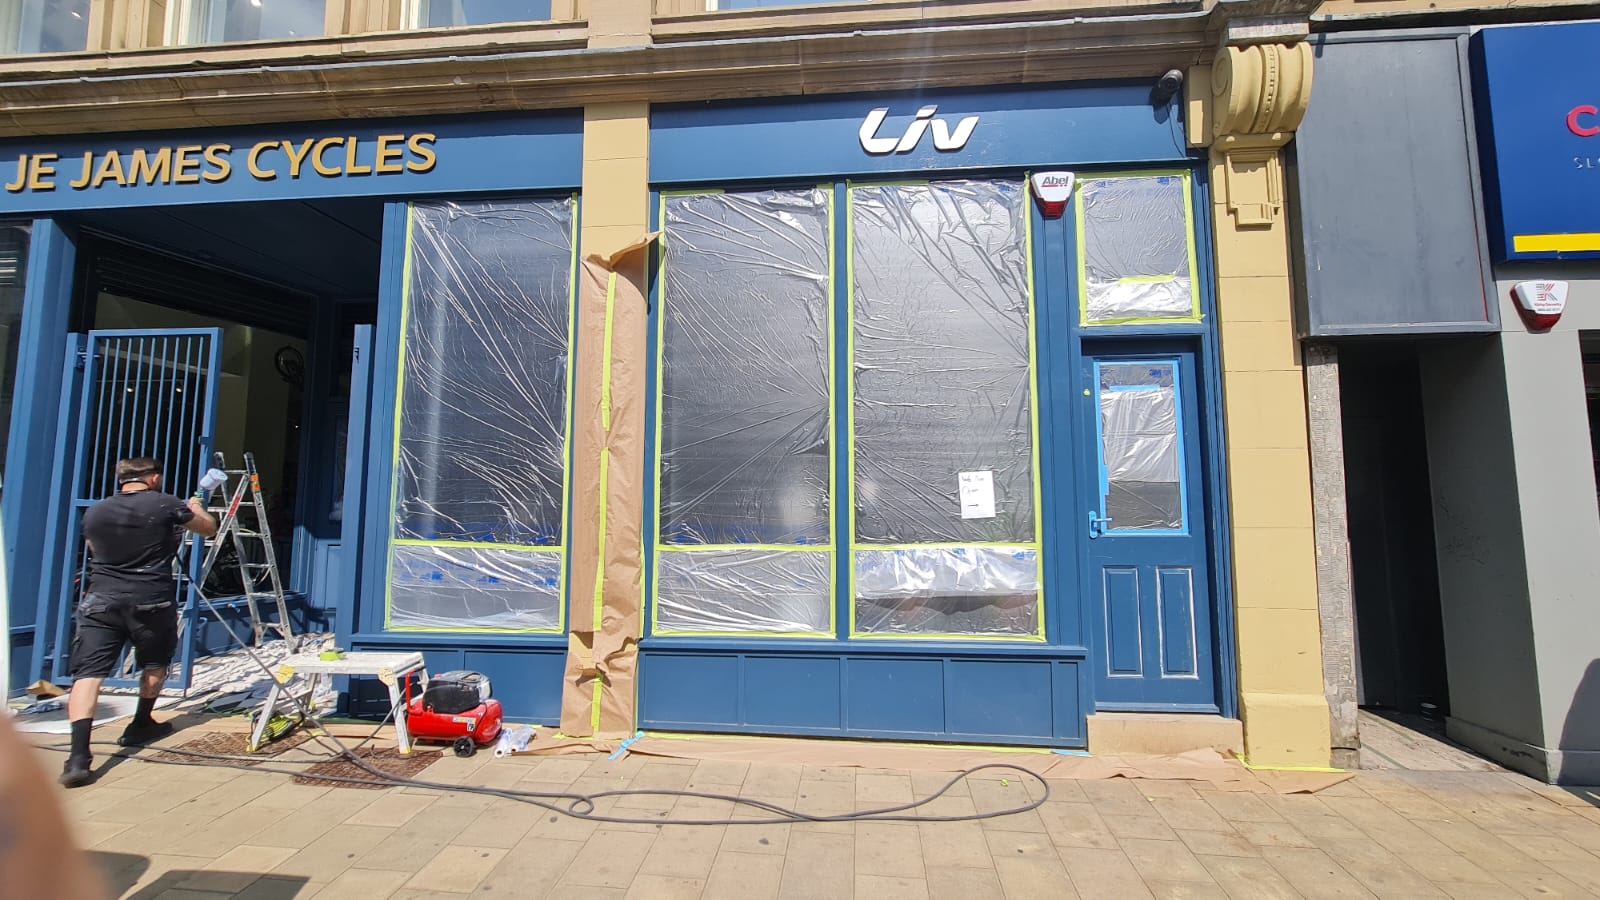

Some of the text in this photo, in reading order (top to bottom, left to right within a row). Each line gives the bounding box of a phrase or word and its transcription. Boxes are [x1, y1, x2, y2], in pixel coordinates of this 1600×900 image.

[859, 104, 980, 156] Liv
[5, 133, 437, 191] JE JAMES CYCLES
[1573, 156, 1600, 169] SL
[1042, 175, 1070, 185] Abel
